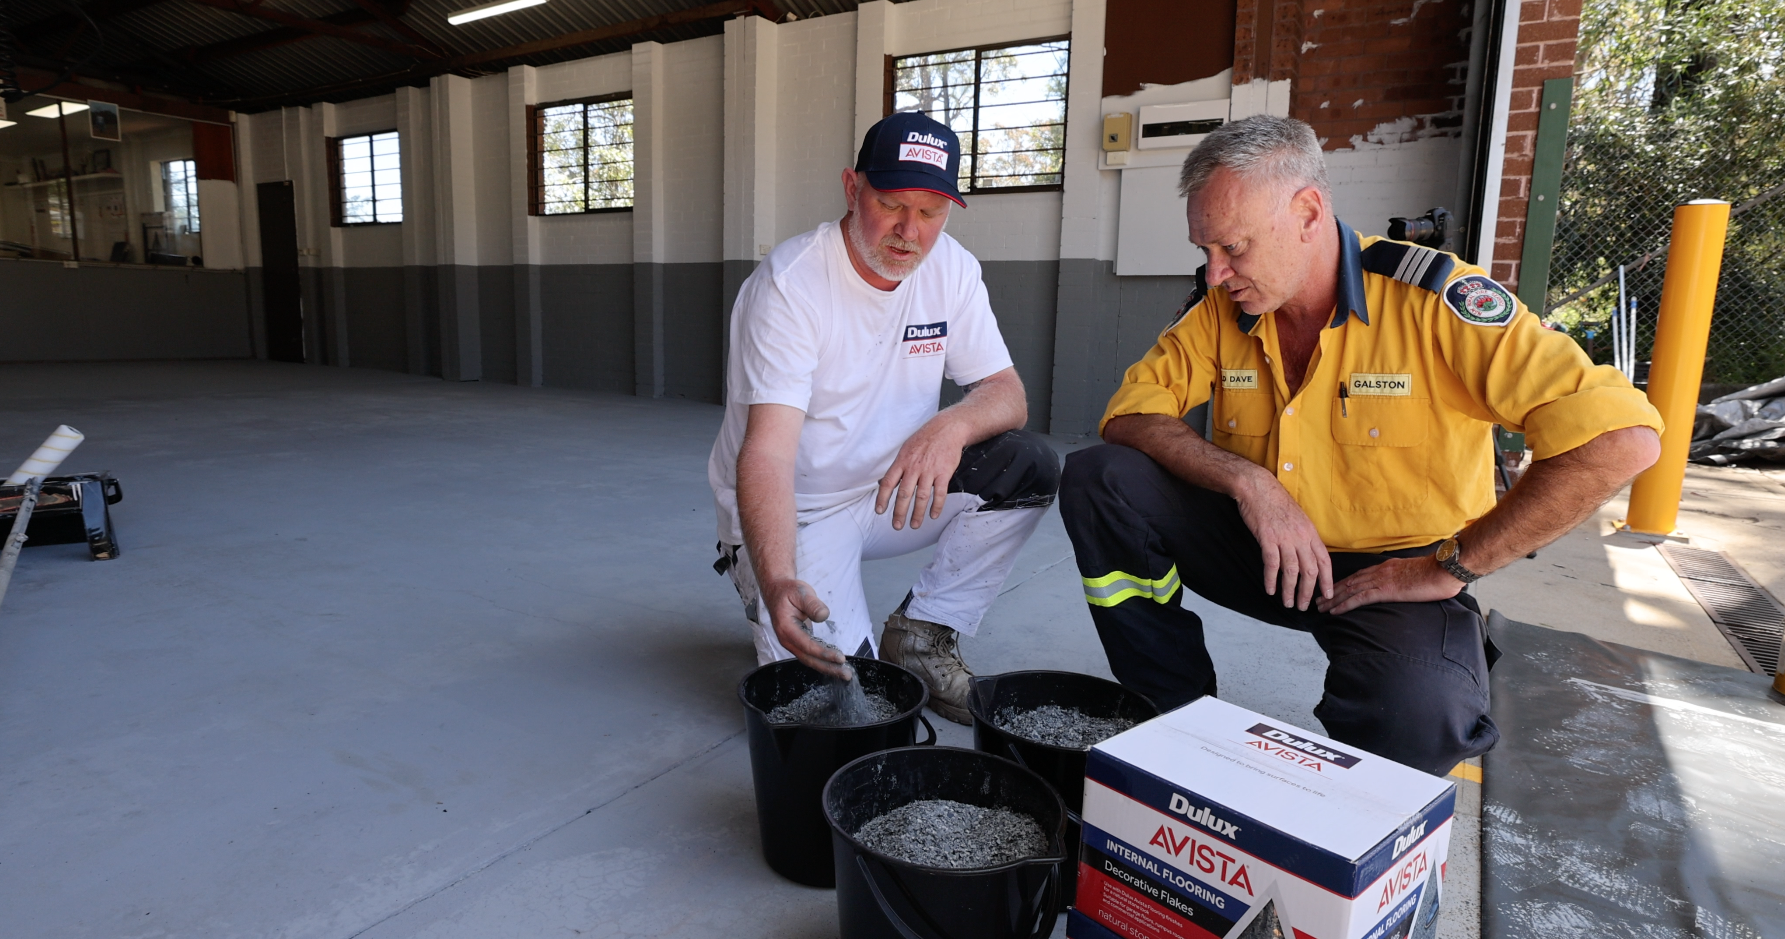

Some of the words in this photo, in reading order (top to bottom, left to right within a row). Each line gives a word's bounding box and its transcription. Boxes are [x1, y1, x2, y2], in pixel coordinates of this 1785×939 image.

[906, 148, 942, 164] AVISTA
[907, 132, 944, 148] Dulux
[907, 326, 941, 338] Dulux
[909, 342, 944, 354] AVISTA
[1354, 380, 1405, 389] GALSTON
[1244, 740, 1322, 772] AVISTA
[1261, 730, 1341, 762] Dulux
[1200, 746, 1236, 762] Designed
[1245, 764, 1265, 775] bring
[1266, 772, 1301, 788] surfaces
[1312, 790, 1326, 798] life
[1169, 792, 1239, 840] Dulux
[1392, 820, 1428, 860] Dulux
[1106, 839, 1161, 876] INTERNAL
[1162, 868, 1225, 910] FLOORING
[1148, 824, 1254, 897] AVISTA
[1104, 860, 1159, 898] Decorative
[1160, 889, 1194, 917] Flakes
[1377, 850, 1427, 914] AVISTA
[1099, 909, 1128, 931] natural
[1148, 905, 1165, 919] Flooring
[1385, 894, 1416, 930] FLOORING
